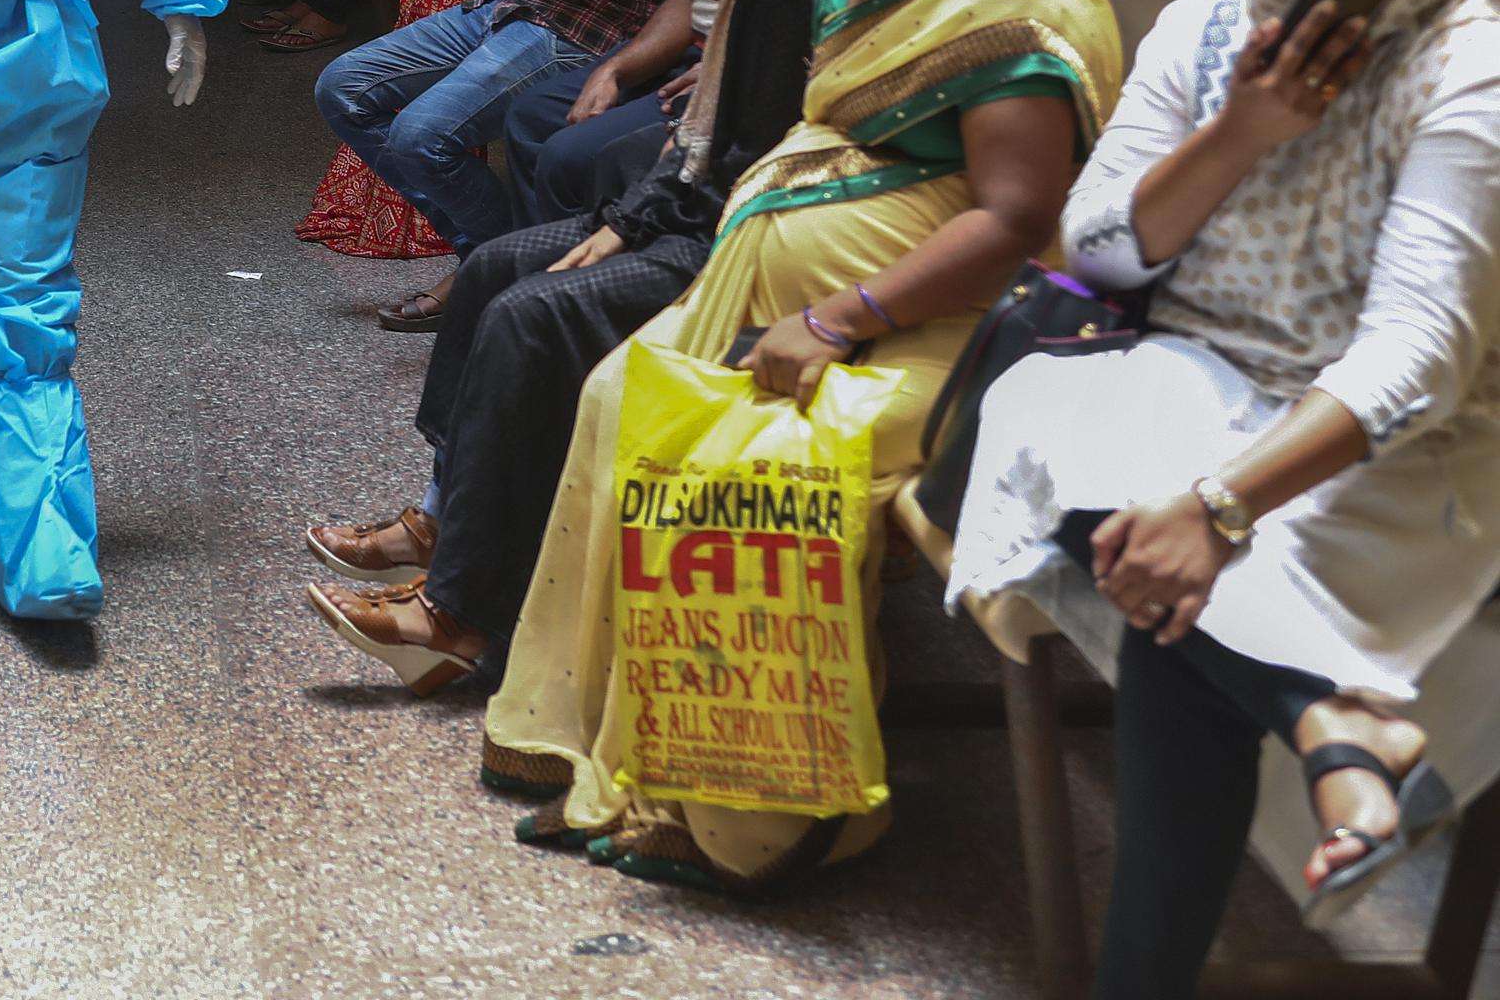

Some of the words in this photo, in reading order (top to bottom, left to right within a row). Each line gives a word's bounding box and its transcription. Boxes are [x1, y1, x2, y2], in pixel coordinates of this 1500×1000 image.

[622, 526, 845, 606] LATA
[622, 607, 723, 650] JEANS
[666, 702, 706, 741] ALL
